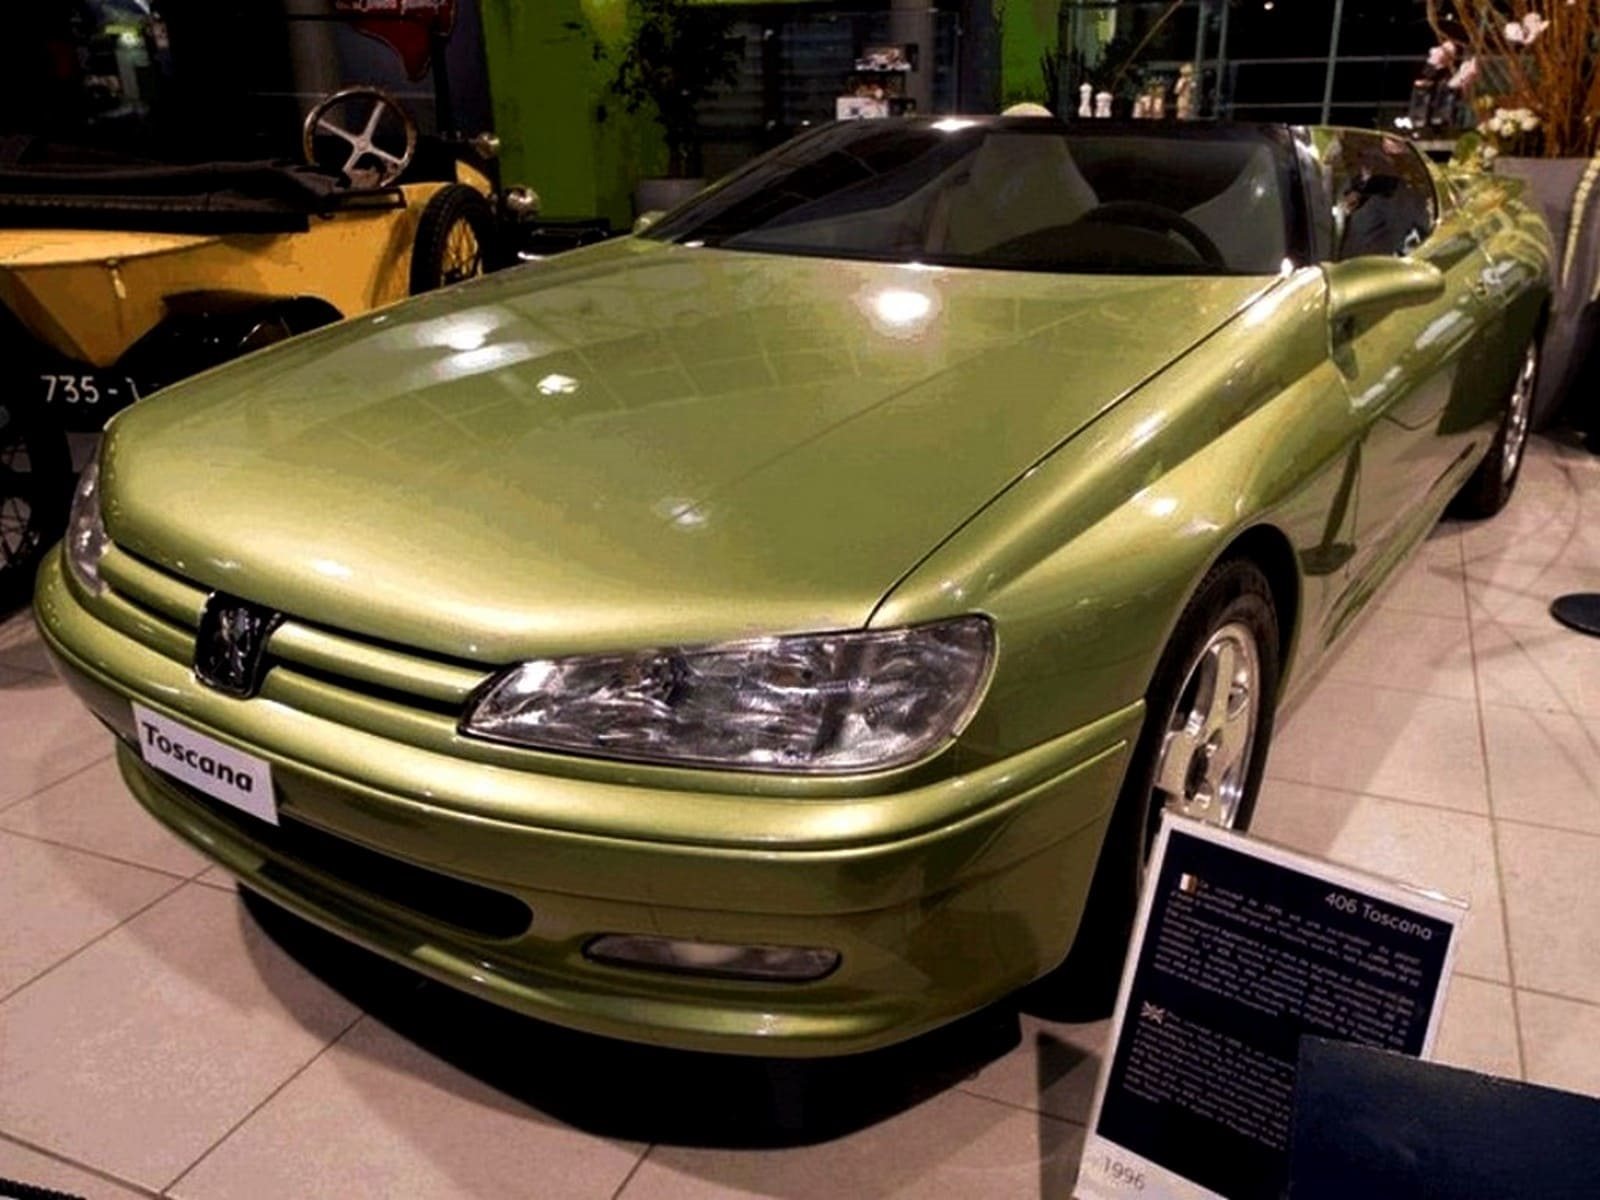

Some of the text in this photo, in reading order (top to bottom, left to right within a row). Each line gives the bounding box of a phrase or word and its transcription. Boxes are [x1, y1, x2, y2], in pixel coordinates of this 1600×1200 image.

[142, 720, 254, 793] Toscana
[1325, 892, 1433, 941] 406 Toscana
[1104, 1157, 1145, 1191] 1996
